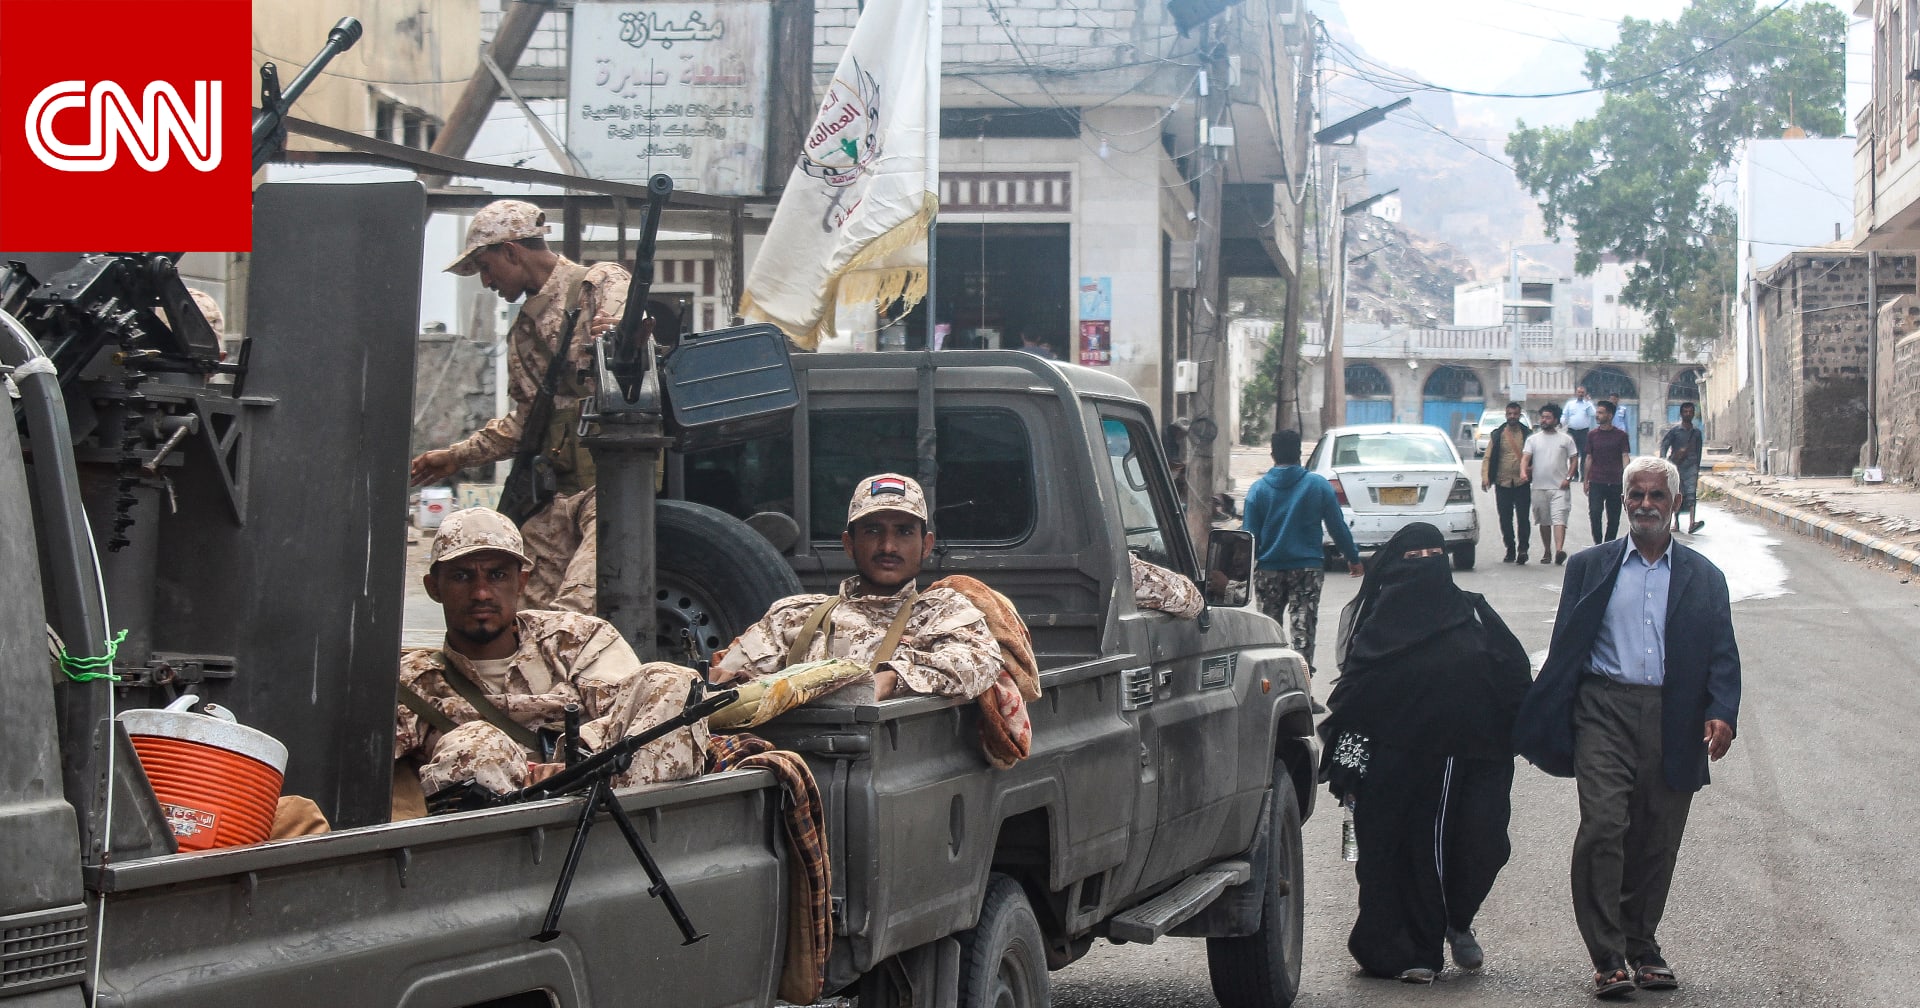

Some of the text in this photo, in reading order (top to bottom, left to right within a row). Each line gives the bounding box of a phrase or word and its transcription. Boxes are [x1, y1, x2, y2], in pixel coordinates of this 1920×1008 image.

[618, 11, 725, 49] مخبازة
[595, 52, 747, 99] قلعة صيرة
